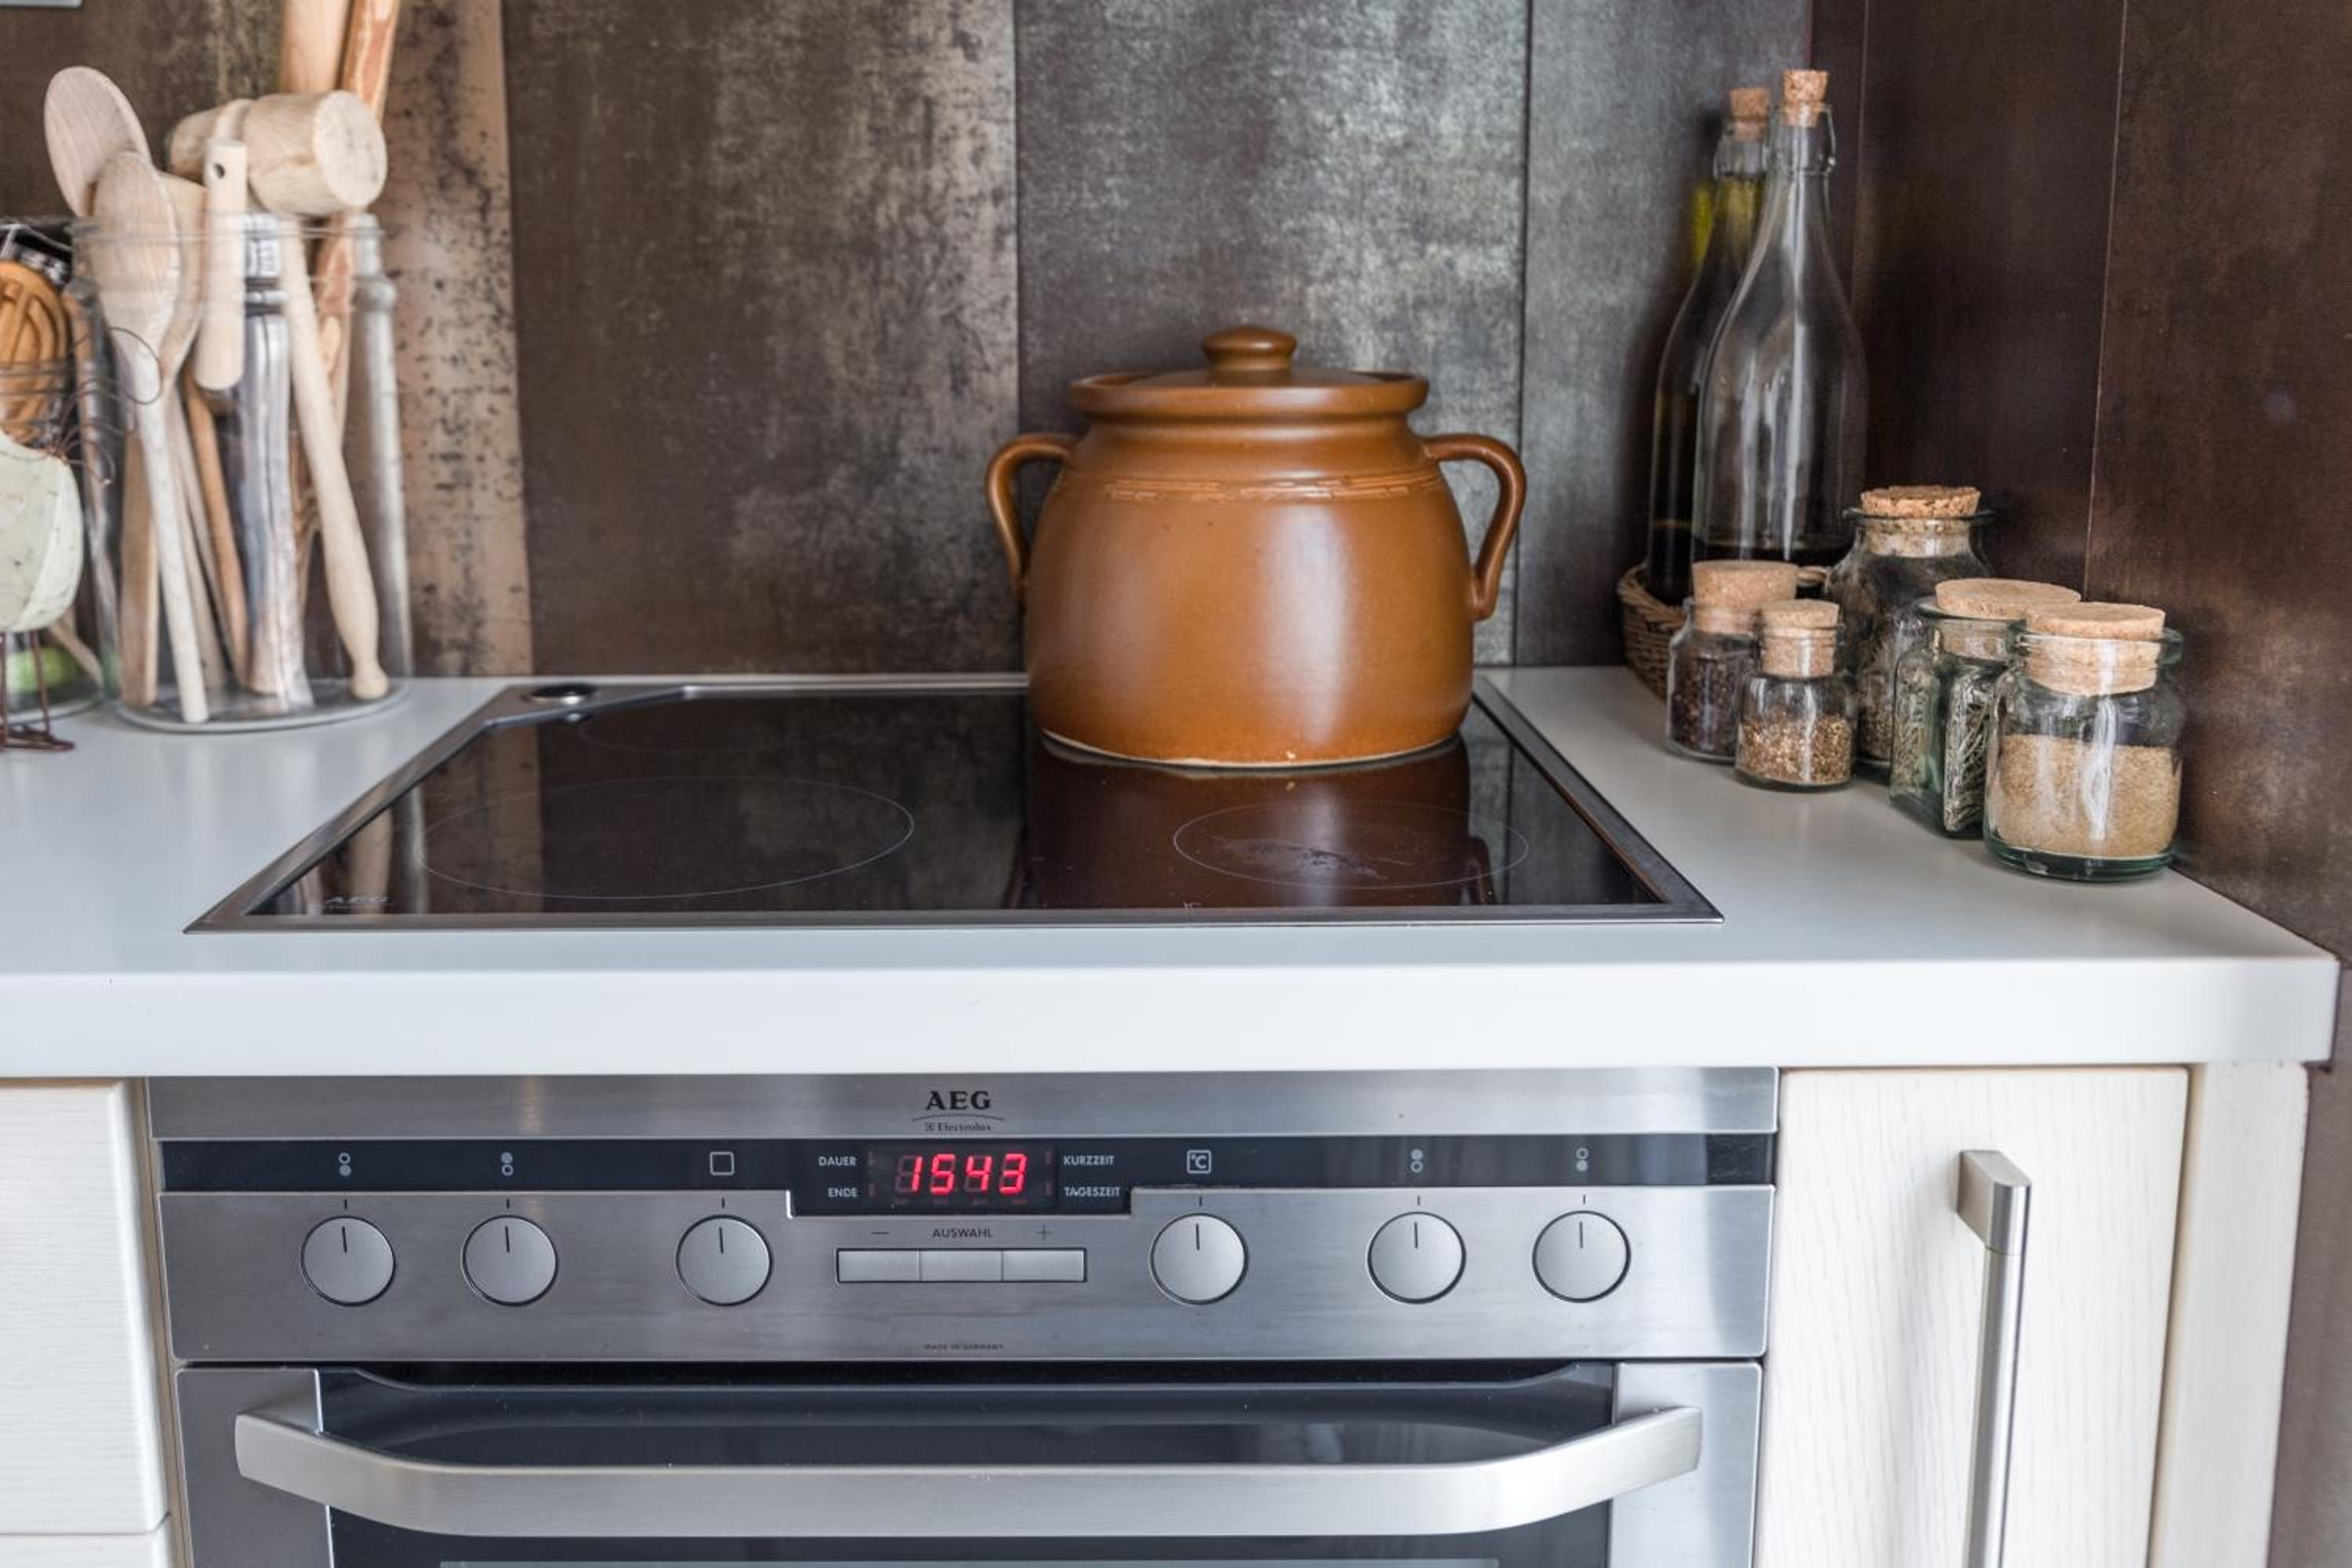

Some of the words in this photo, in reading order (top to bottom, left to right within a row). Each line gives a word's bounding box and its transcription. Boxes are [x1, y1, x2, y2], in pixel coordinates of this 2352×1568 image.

[925, 1087, 991, 1110] AEG
[938, 1121, 991, 1131] Electrolux
[818, 1156, 857, 1166] DAUER
[1063, 1156, 1115, 1166] KURZZEIT
[912, 1153, 1027, 1195] 1543
[827, 1188, 858, 1197] ENDE
[1064, 1186, 1120, 1196] TAGESZEIT
[932, 1229, 992, 1238] AUSWAHL
